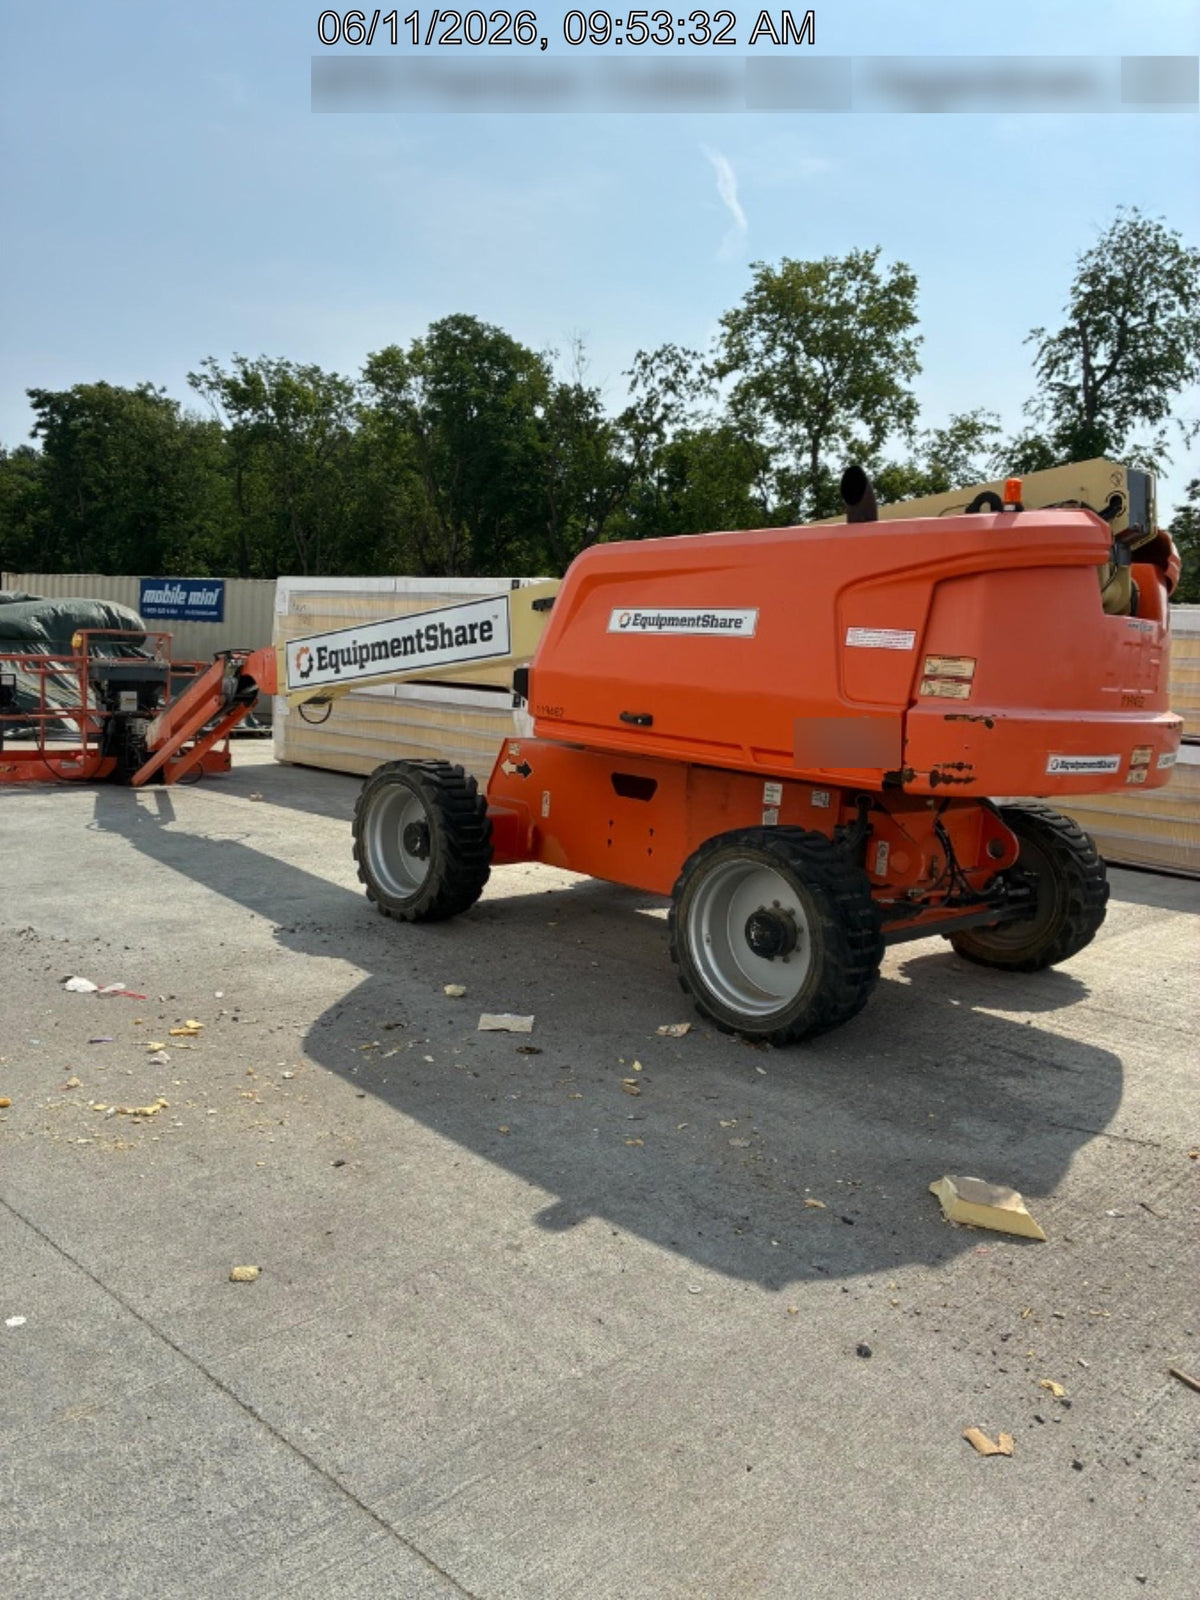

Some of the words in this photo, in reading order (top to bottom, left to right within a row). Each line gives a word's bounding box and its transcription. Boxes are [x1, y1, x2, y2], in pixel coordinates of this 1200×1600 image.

[142, 583, 187, 605] mobile
[632, 612, 743, 630] EquipmentShare
[316, 619, 494, 674] EquipmentShare
